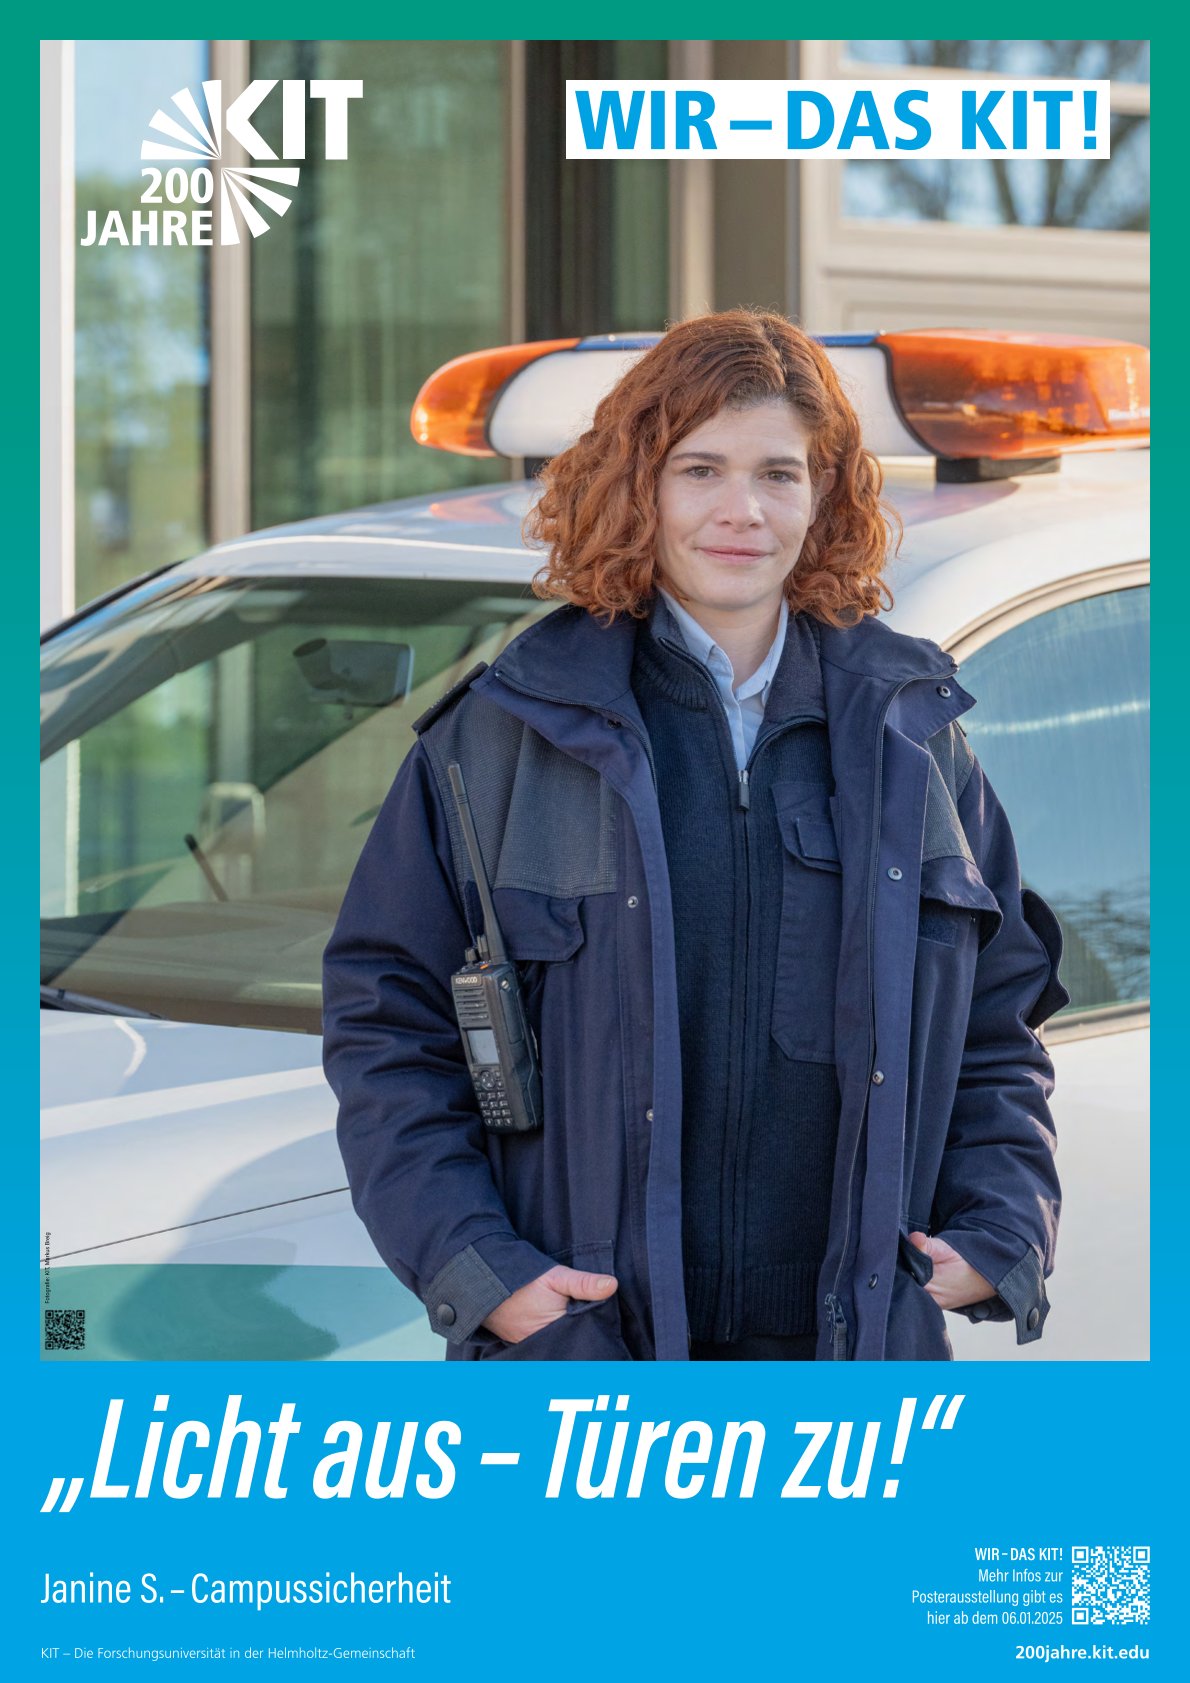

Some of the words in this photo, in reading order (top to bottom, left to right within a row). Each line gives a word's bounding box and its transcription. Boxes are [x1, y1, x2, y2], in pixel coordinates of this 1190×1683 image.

[226, 79, 363, 160] KIT
[961, 90, 1098, 150] KIT!
[140, 167, 214, 204] 200
[80, 210, 213, 246] JAHRE
[312, 1420, 462, 1500] aus
[544, 1394, 766, 1500] Türen
[1039, 1547, 1063, 1561] KIT!
[978, 1568, 1009, 1582] Mehr
[1012, 1568, 1042, 1582] Infos
[1045, 1571, 1063, 1582] zur
[40, 1572, 131, 1604] Janine
[140, 1573, 164, 1604] S.
[191, 1572, 452, 1611] Campussicherheit
[911, 1589, 1019, 1607] Posterausstellung
[1022, 1589, 1046, 1607] gibt
[1049, 1592, 1063, 1604] es
[927, 1611, 951, 1625] hier
[954, 1611, 969, 1625] ab
[971, 1611, 998, 1625] dem
[1002, 1611, 1063, 1625] 06.01.2025
[41, 1647, 60, 1659] KIT
[74, 1647, 94, 1659] Die
[98, 1647, 226, 1662] Forschungsuniversität
[230, 1647, 240, 1659] in
[244, 1647, 264, 1659] der
[268, 1647, 416, 1660] Helmholtz-Gemeinschaft
[1015, 1645, 1150, 1663] 200jahre.kit.edu
